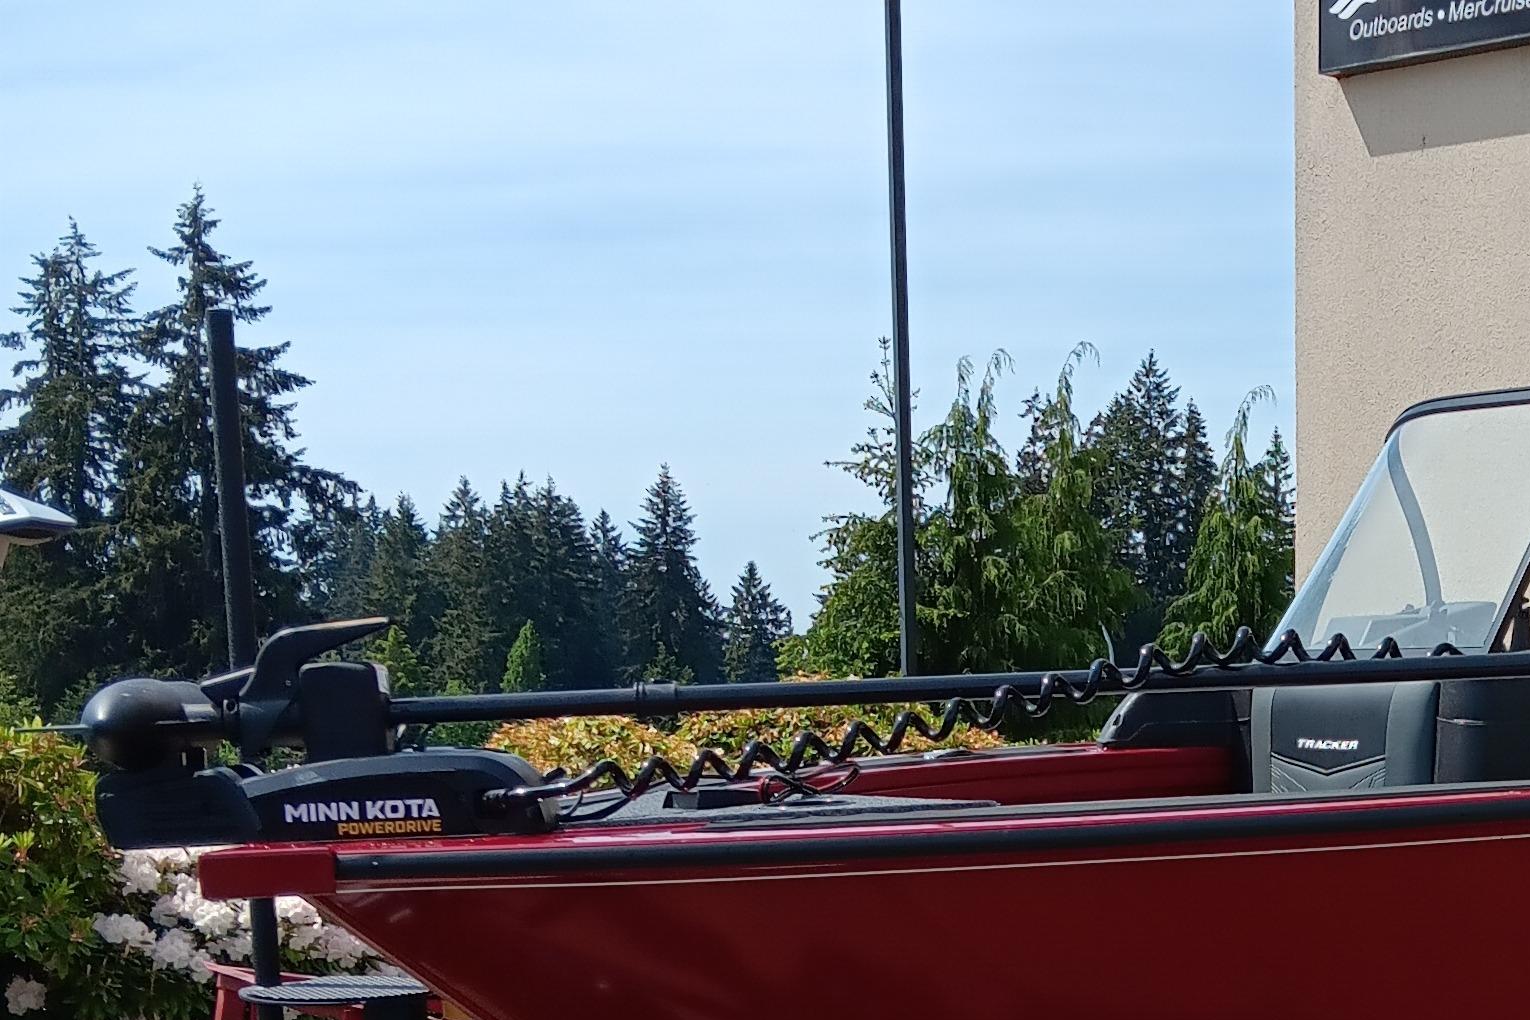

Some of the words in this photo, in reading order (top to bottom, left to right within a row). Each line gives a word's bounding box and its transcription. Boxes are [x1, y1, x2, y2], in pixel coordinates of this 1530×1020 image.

[1349, 8, 1433, 41] Outboards
[1297, 738, 1359, 750] TRACKER
[284, 801, 359, 823] MINN
[365, 798, 441, 820] KOTA
[338, 819, 442, 836] POWERDRIVE
